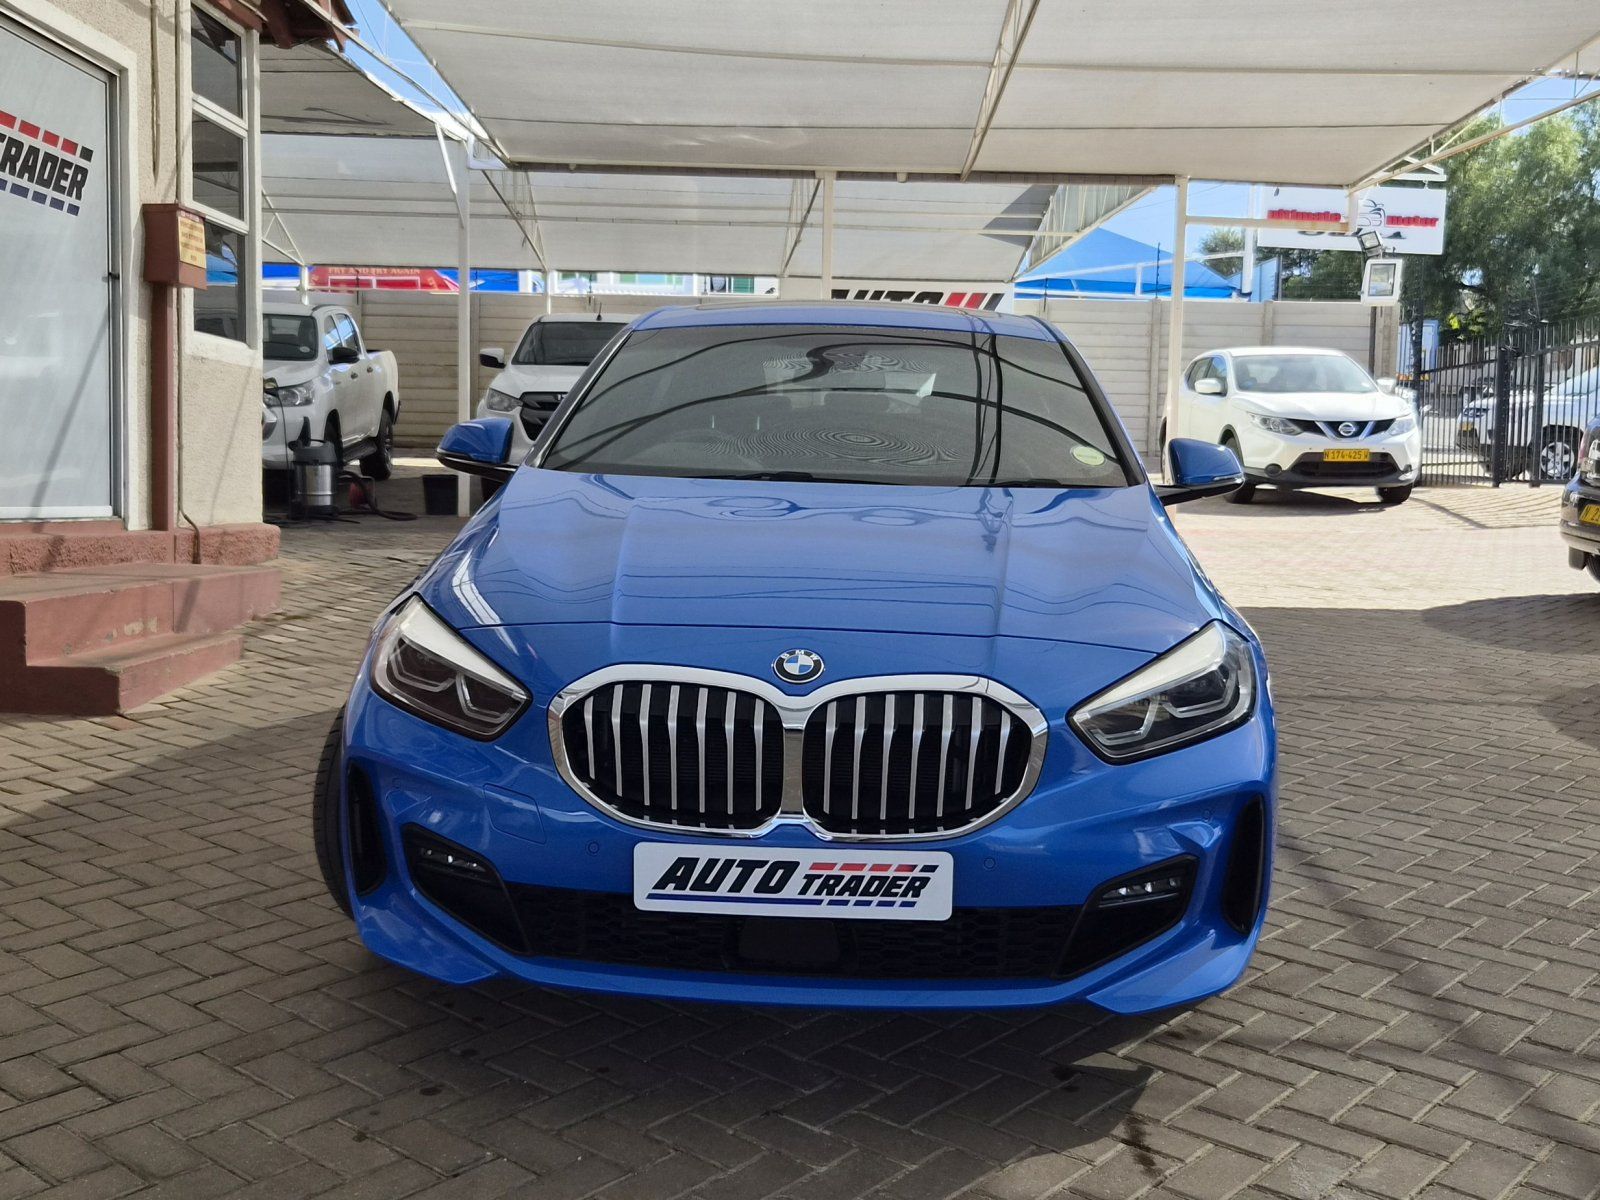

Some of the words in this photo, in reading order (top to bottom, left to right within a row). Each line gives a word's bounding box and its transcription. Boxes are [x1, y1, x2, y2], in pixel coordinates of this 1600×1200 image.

[779, 649, 821, 660] BMW
[652, 857, 800, 894] AUTO
[797, 873, 932, 898] TRADER
